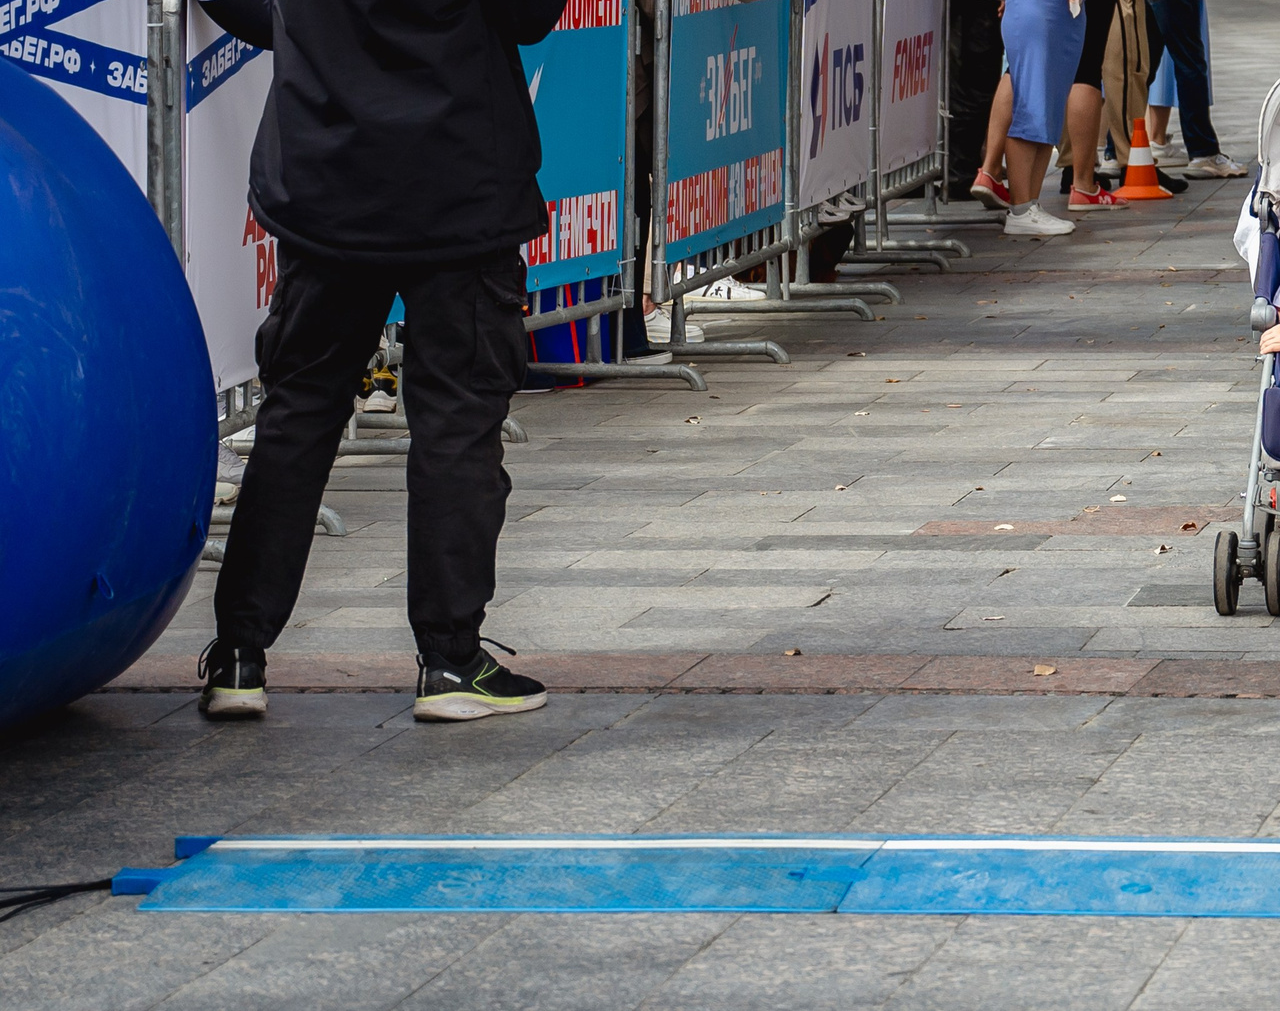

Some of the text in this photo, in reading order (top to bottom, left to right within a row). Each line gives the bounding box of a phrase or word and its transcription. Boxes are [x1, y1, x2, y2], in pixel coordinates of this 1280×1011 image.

[831, 42, 864, 131] ПСБ
[891, 30, 934, 104] FONBET
[559, 190, 618, 261] #МЕЧТА
[666, 165, 728, 244] #АДРЕНАЛИН
